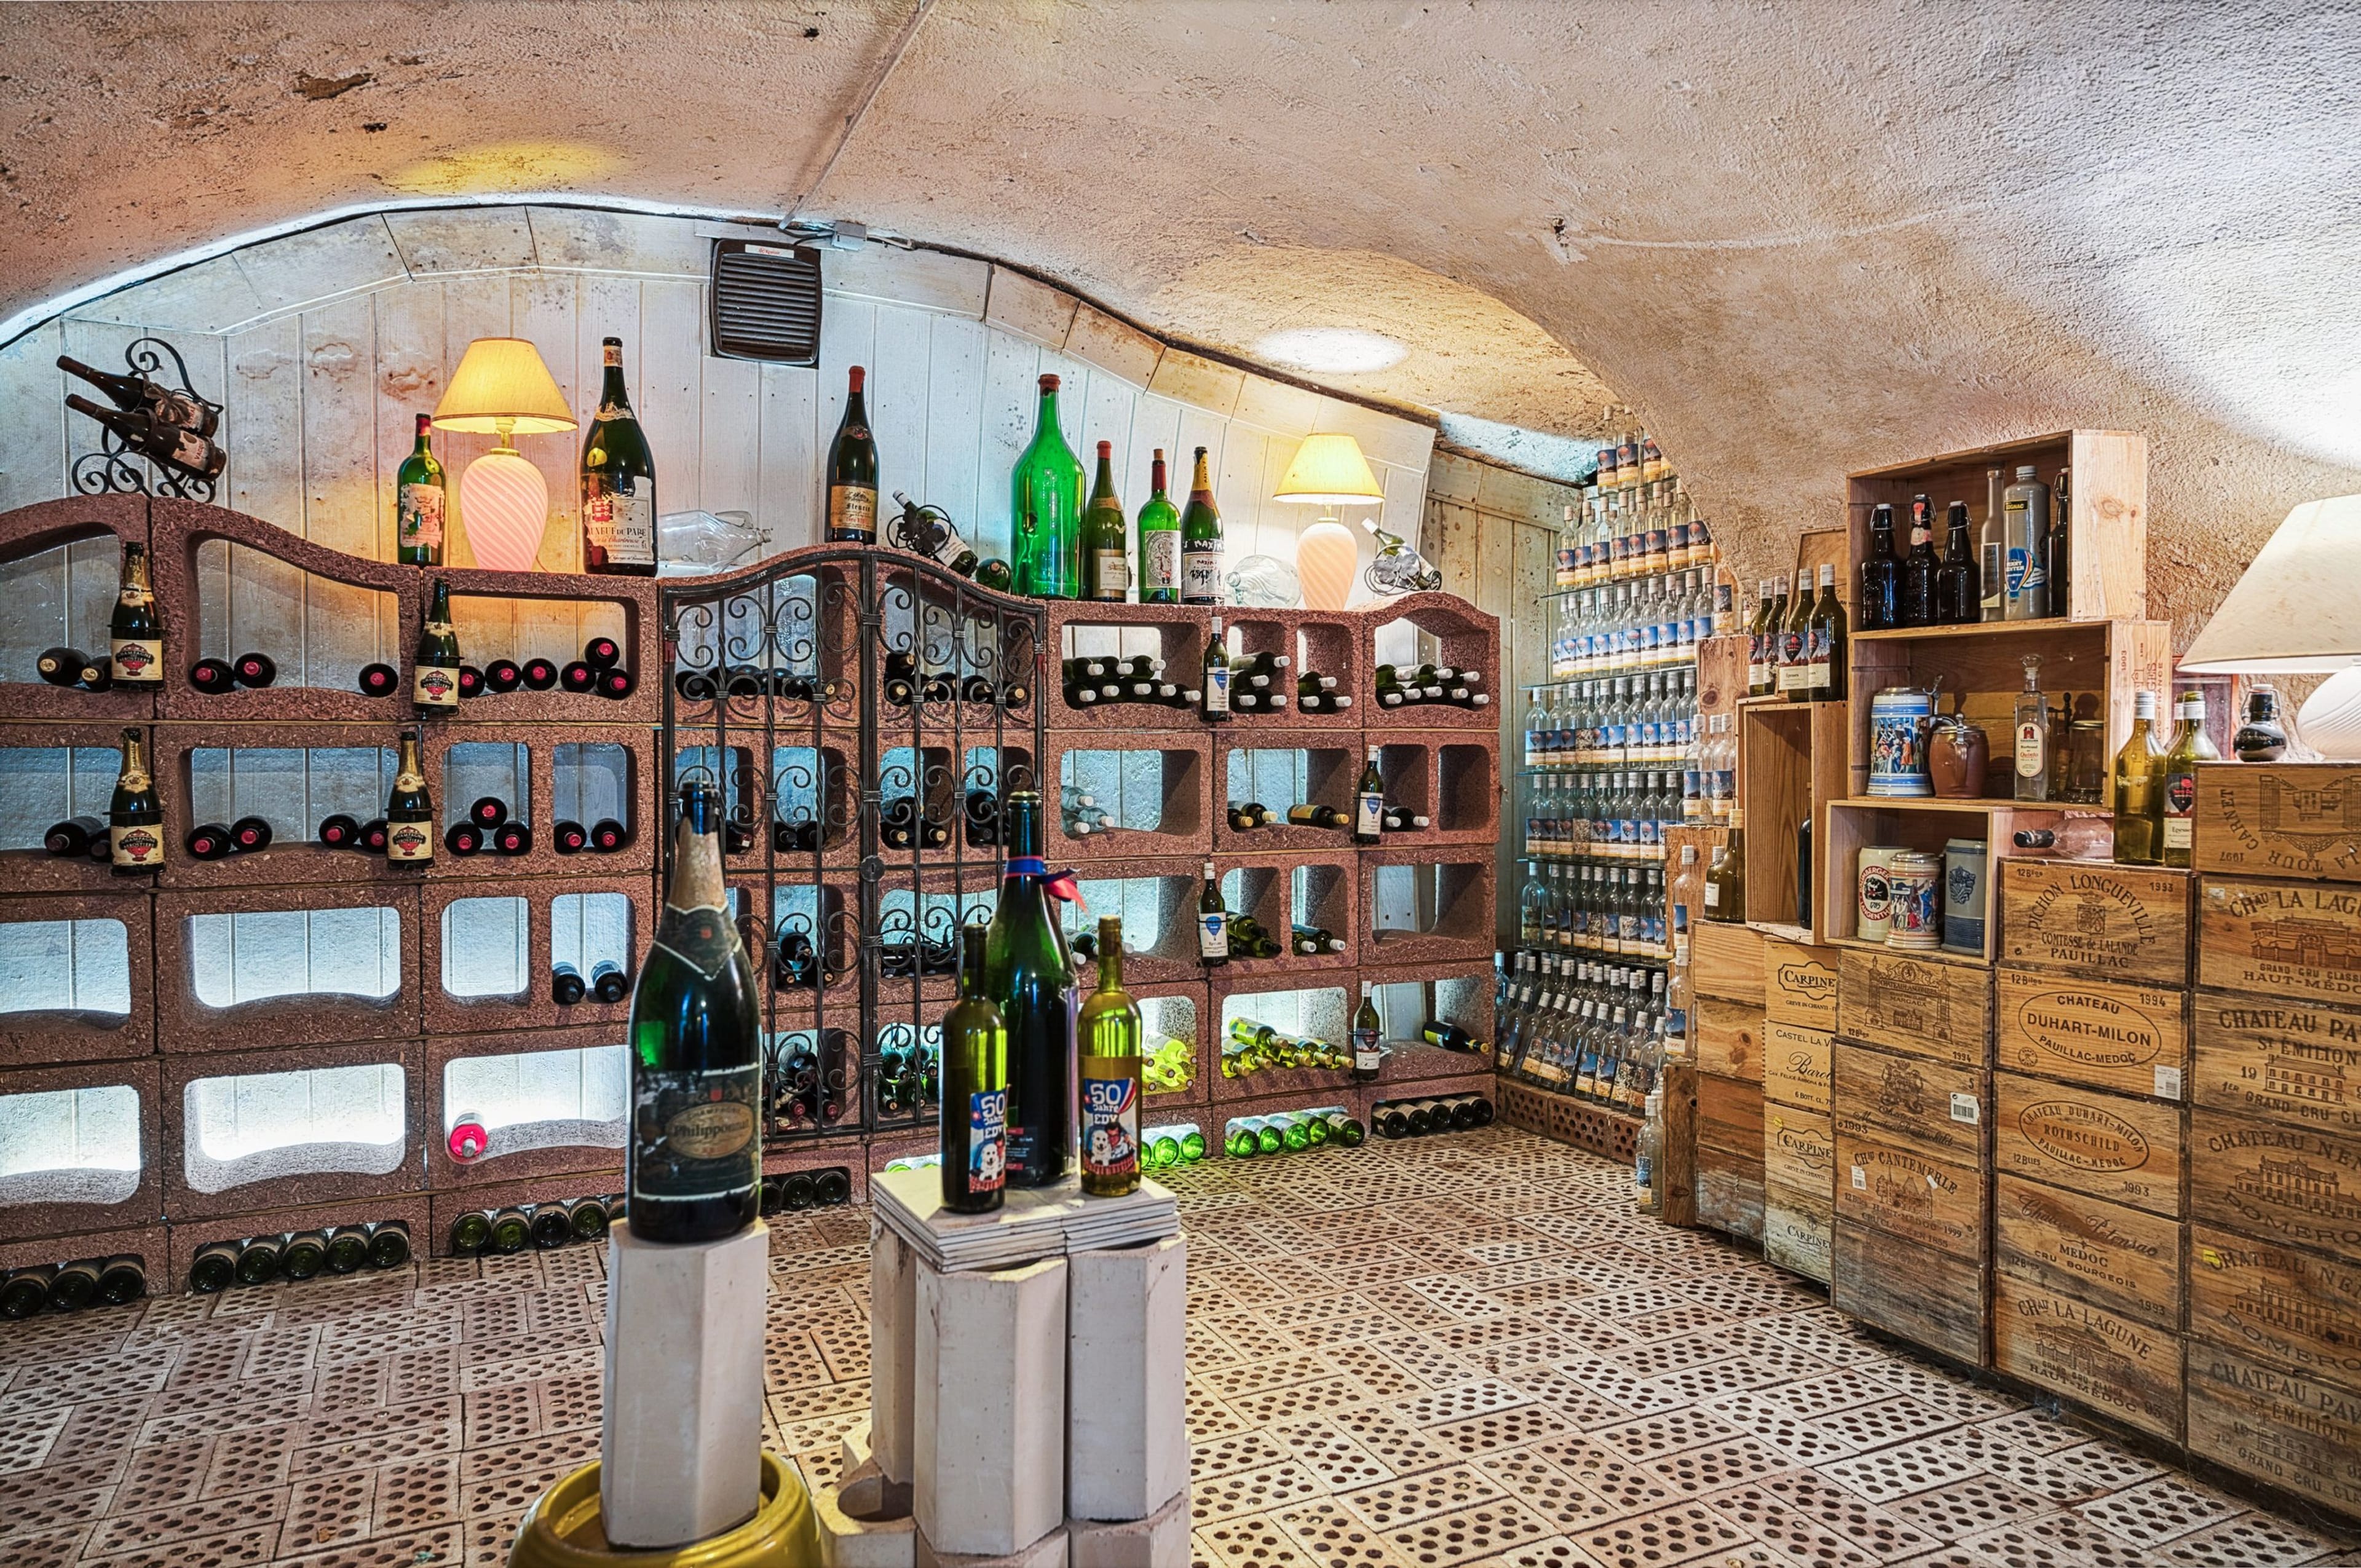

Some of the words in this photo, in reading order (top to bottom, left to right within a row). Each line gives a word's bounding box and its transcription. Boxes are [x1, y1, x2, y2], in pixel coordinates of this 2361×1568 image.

[627, 527, 646, 536] PAPE
[2220, 789, 2260, 851] CARNET
[2268, 849, 2323, 872] TOUR
[2149, 882, 2173, 892] 1993
[2028, 881, 2065, 931] PICHON
[2070, 874, 2156, 945] LONGUEVILLE
[2277, 891, 2304, 909] LA
[2042, 932, 2083, 948] COMTESSE
[2051, 947, 2129, 968] PAUILLAC
[1784, 970, 1837, 987] CARPINE
[2260, 963, 2291, 975] GRAND
[2298, 967, 2320, 979] CRU
[1890, 996, 1927, 1007] MARGAUX
[2057, 995, 2120, 1014] CHATEAU
[2139, 993, 2166, 1007] 1994
[2027, 1013, 2151, 1046] DUHART-MILON
[2219, 1010, 2316, 1033] CHATEAU
[1776, 1029, 1808, 1044] CASTEL
[1810, 1035, 1821, 1046] LA
[1953, 1051, 1971, 1063] 1994
[2039, 1035, 2137, 1063] PAUILLAC-MEDOC
[2241, 1066, 2257, 1080] 19
[981, 1093, 1005, 1117] 50
[1090, 1083, 1121, 1105] 50
[2245, 1091, 2290, 1113] GRAND
[2301, 1105, 2329, 1121] CRU
[1094, 1114, 1118, 1125] EDV
[1844, 1121, 1869, 1134] 1993
[2023, 1105, 2062, 1125] CHATEAU
[2068, 1106, 2145, 1154] DUHART-MILON
[2044, 1124, 2120, 1152] ROTHSCHILD
[2209, 1130, 2304, 1152] CHATEAU
[1878, 1151, 1958, 1195] CANTEMERLE
[2124, 1181, 2150, 1197] 1993
[1862, 1212, 1878, 1223] CRU
[1928, 1234, 1948, 1248] 1855
[1944, 1225, 1963, 1238] 1999
[2085, 1214, 2159, 1257] Potensac
[2059, 1244, 2109, 1268] MEDOC
[2035, 1250, 2057, 1263] CRU
[2066, 1261, 2137, 1289] BOURGEOIS
[2138, 1298, 2166, 1317] 1993
[2054, 1300, 2076, 1320] LA
[2083, 1309, 2152, 1360] LAGUNE
[2238, 1447, 2283, 1476] GRAND
[2294, 1470, 2322, 1492] CRU
